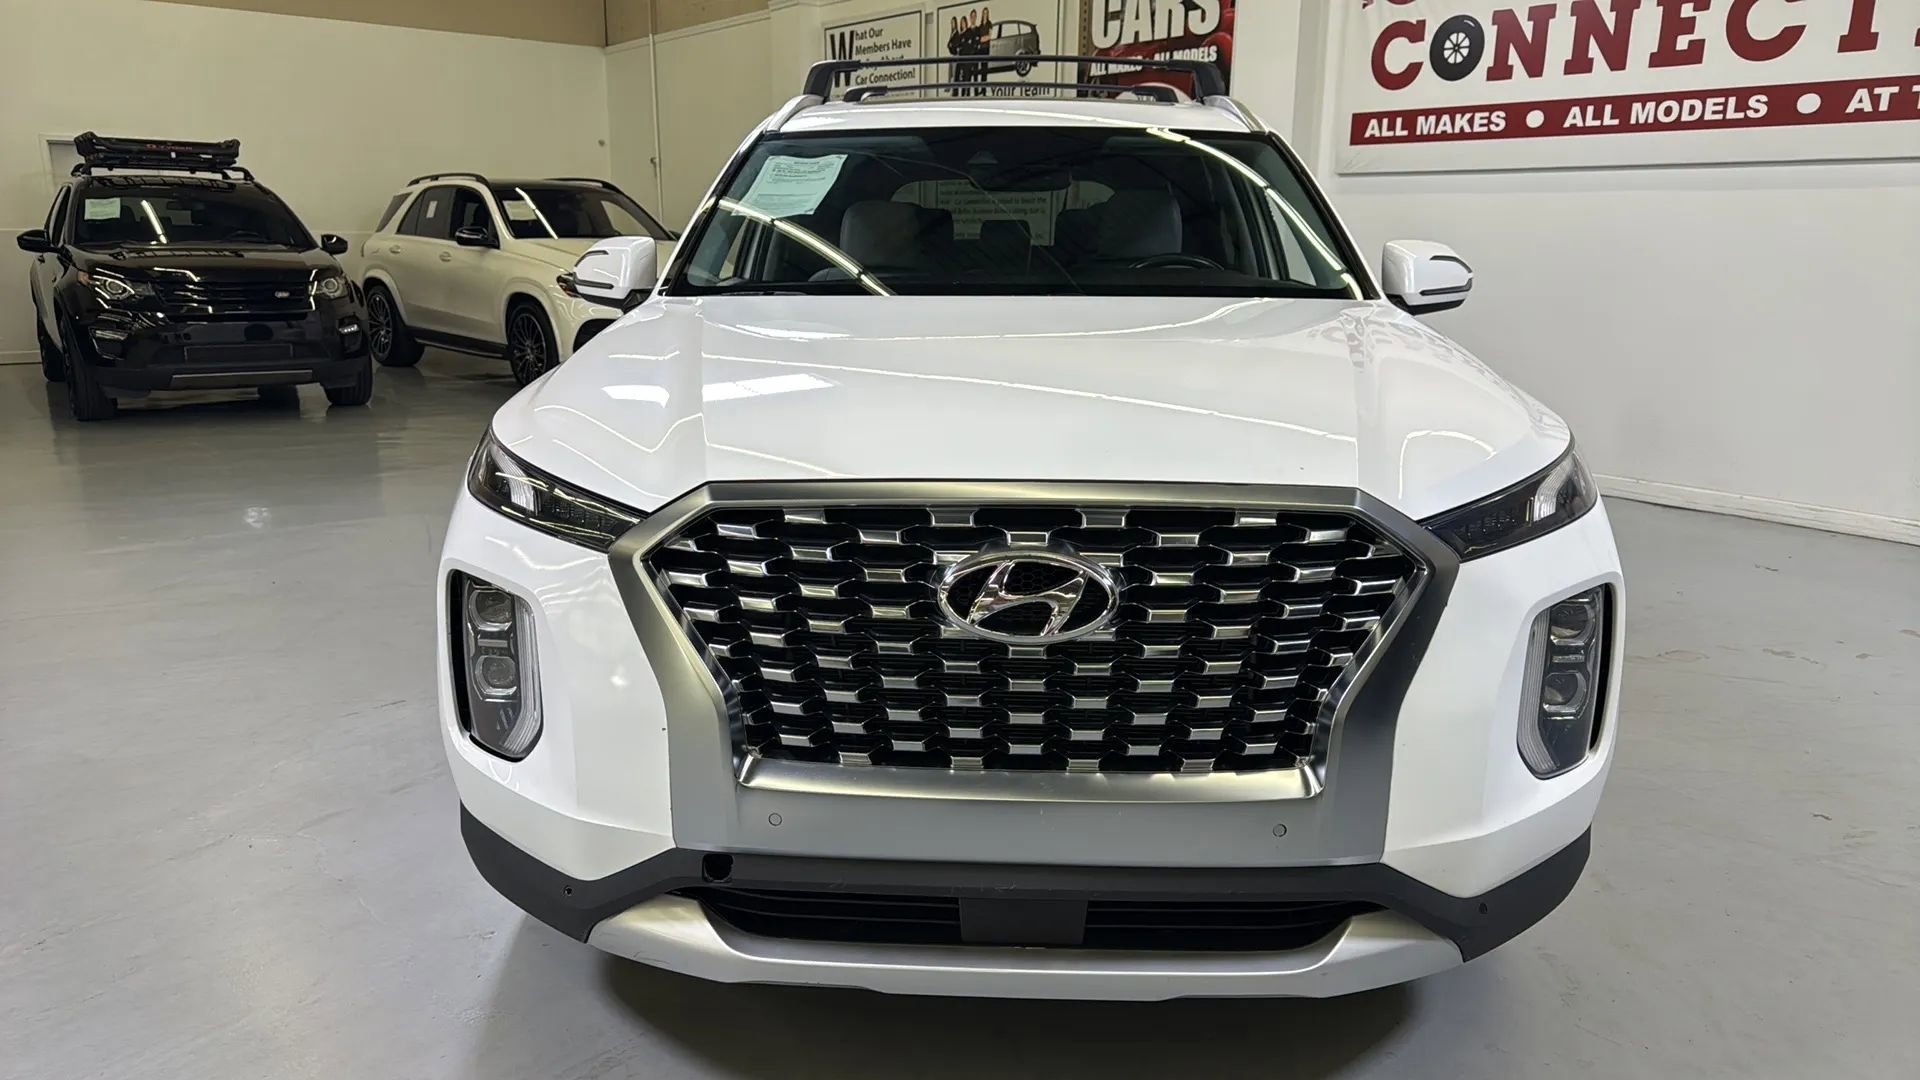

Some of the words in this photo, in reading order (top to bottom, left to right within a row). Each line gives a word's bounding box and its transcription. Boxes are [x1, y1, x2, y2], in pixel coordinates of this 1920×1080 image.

[868, 27, 883, 39] Our
[1091, 0, 1221, 49] CARS
[855, 42, 890, 56] Members
[891, 38, 912, 49] Have
[1090, 62, 1107, 77] ALL
[1173, 45, 1218, 62] MODELS
[1371, 0, 1920, 91] CONNECT
[855, 74, 868, 86] Car
[869, 67, 916, 84] Connection!
[1364, 117, 1409, 138] ALL
[1416, 111, 1506, 136] MAKES
[1563, 104, 1620, 128] ALL
[1630, 94, 1769, 125] MODELS
[1845, 86, 1900, 113] AT
